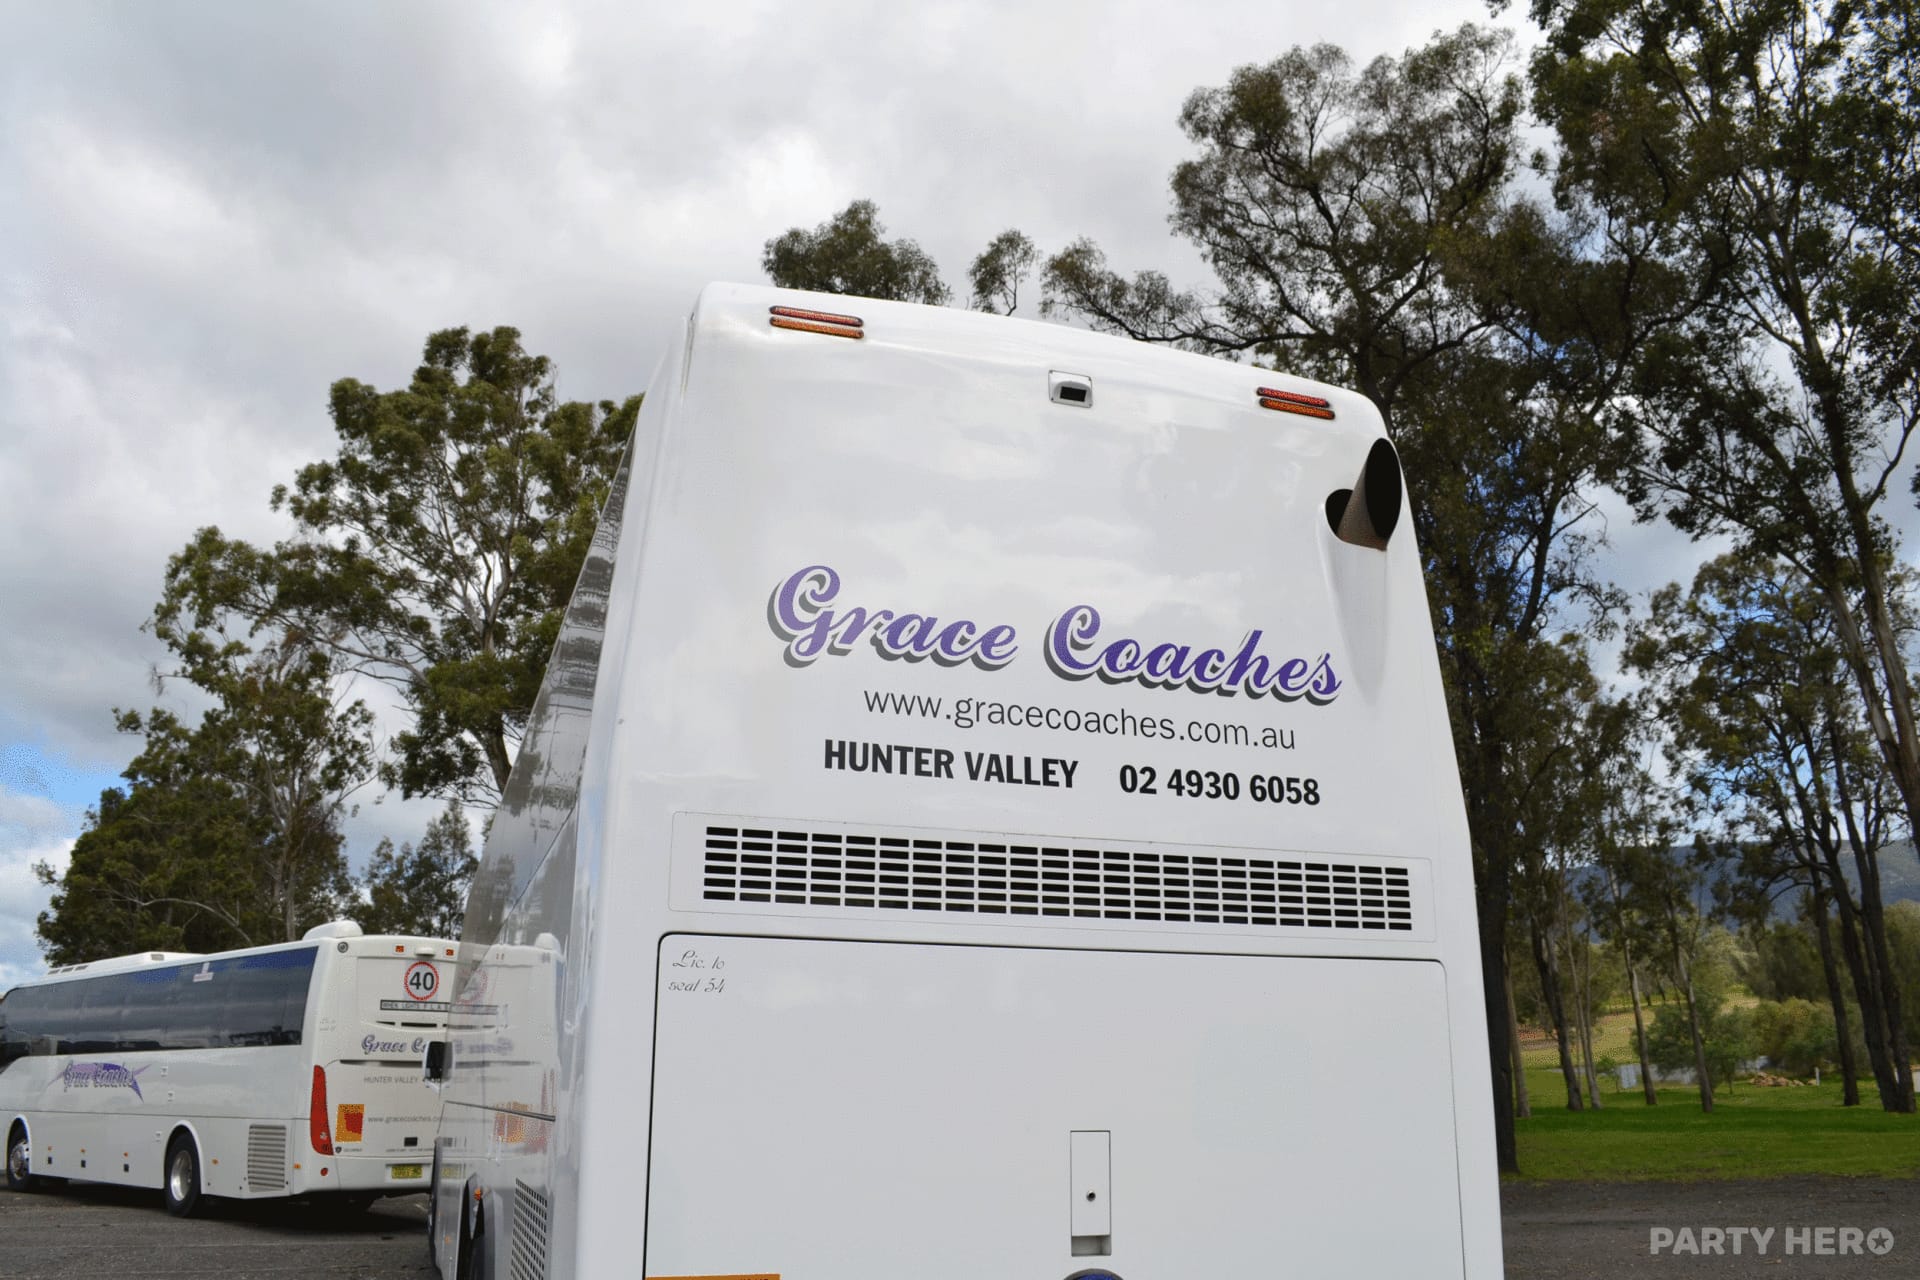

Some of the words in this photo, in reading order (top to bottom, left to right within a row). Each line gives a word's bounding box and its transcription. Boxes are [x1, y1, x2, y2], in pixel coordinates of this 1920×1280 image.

[767, 565, 1018, 671] Grace
[1043, 605, 1342, 705] Coaches
[864, 690, 1296, 749] www.gracecoaches.com.au
[824, 739, 955, 779] HUNTER
[964, 751, 1079, 788] VALLEY
[1119, 764, 1158, 795] 02
[1167, 768, 1240, 801] 4930
[1249, 774, 1321, 805] 6058
[409, 971, 435, 991] 40
[361, 1034, 407, 1055] Grace
[363, 1076, 392, 1084] HUNTER
[395, 1076, 418, 1085] VALLEY
